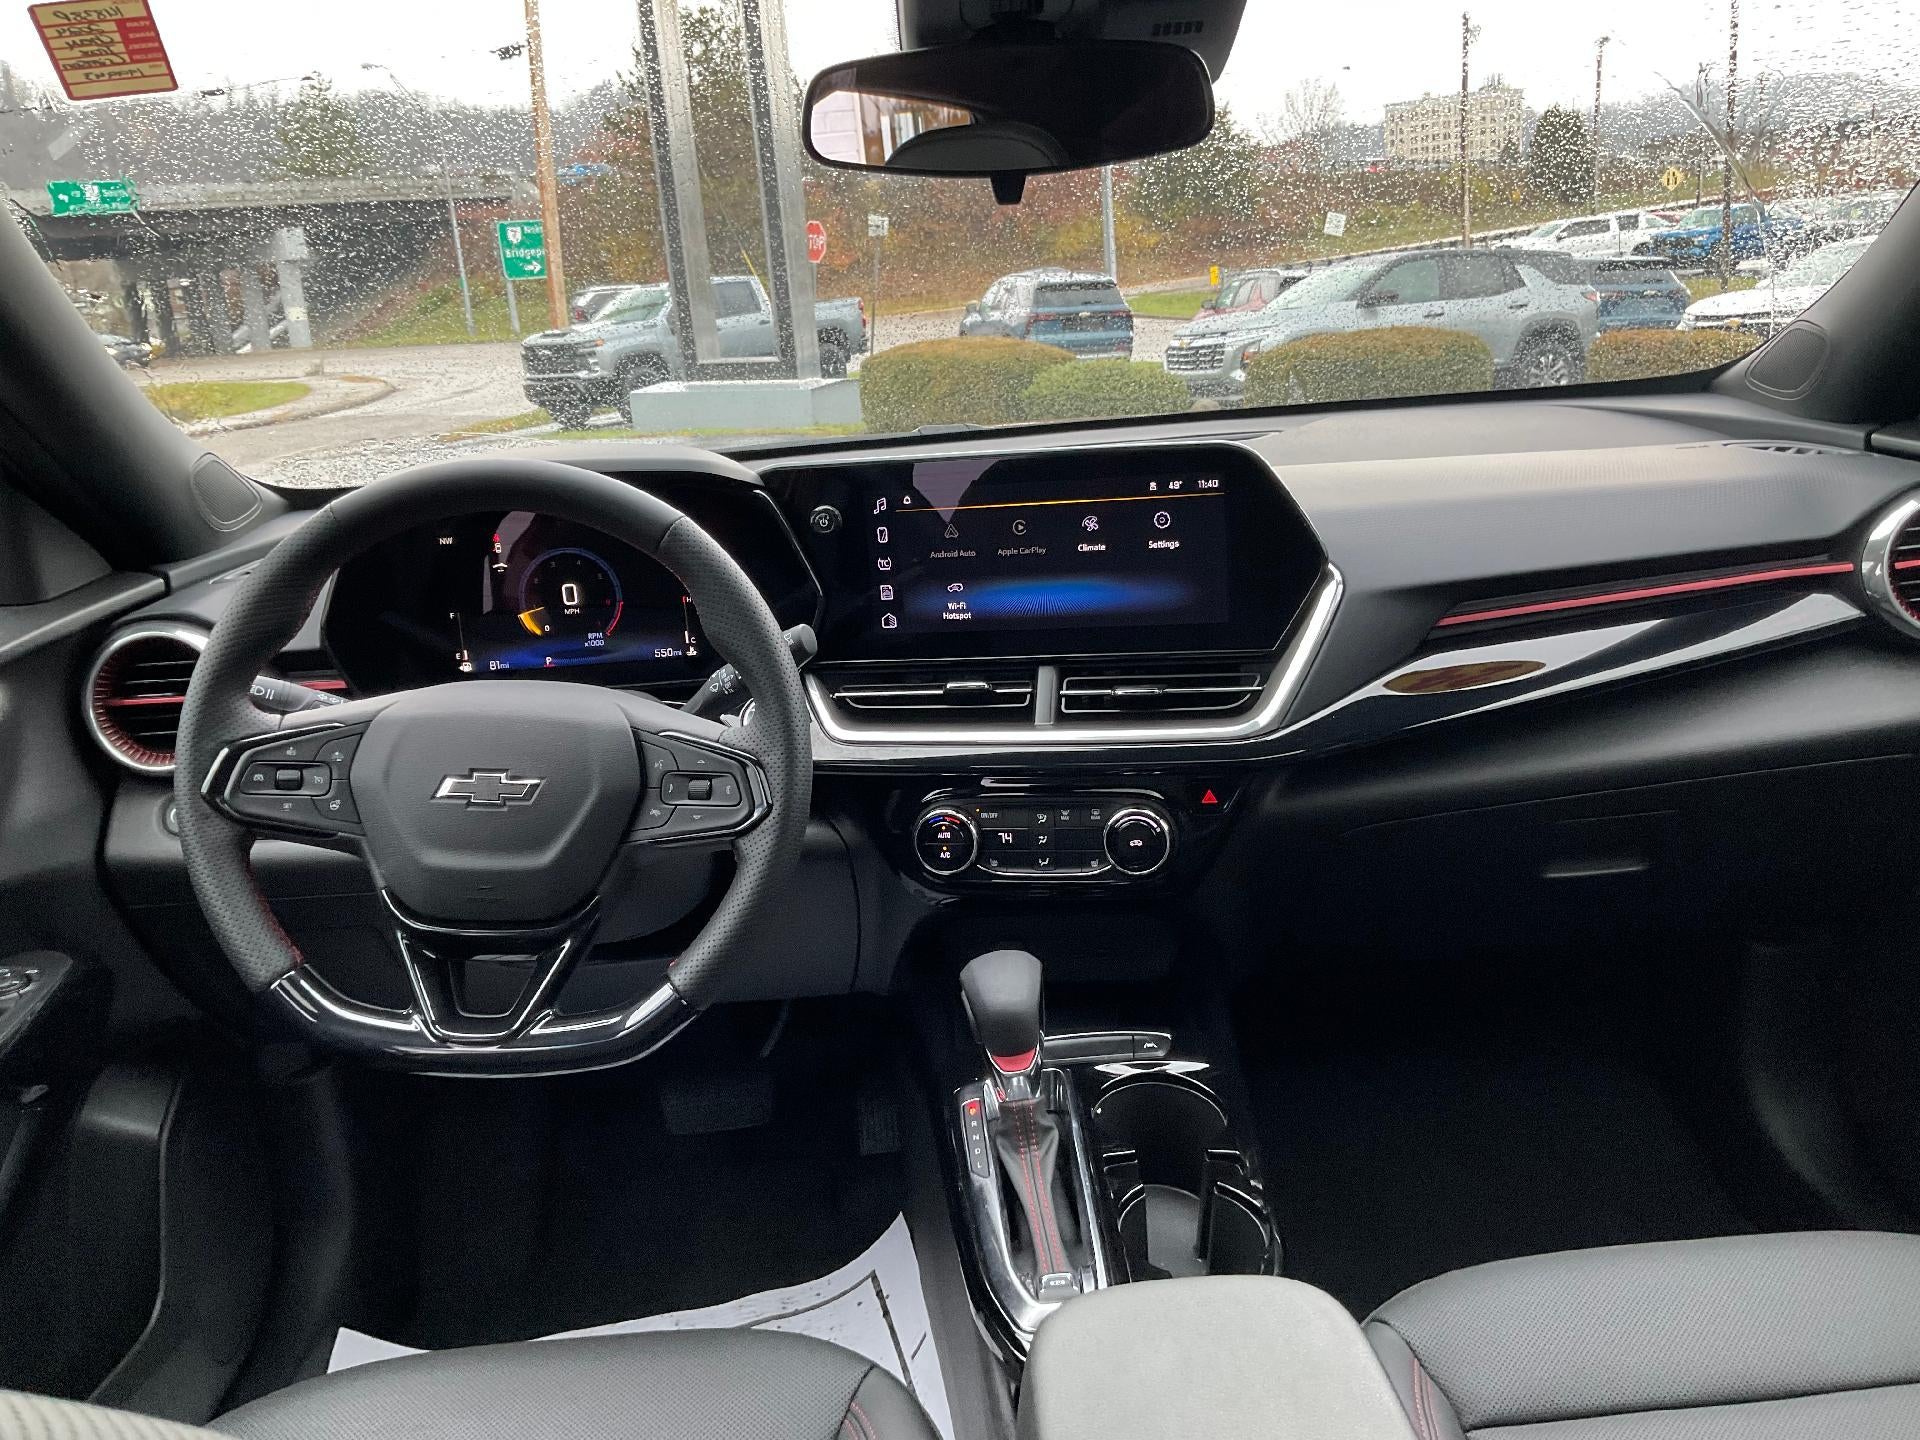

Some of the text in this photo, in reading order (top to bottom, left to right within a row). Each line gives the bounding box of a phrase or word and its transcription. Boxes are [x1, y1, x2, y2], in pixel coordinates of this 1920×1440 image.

[1198, 479, 1220, 489] 11:40
[439, 536, 453, 545] NW
[1148, 539, 1180, 551] Settings
[997, 546, 1047, 557] Apple CarPlay
[1077, 542, 1107, 552] Climate
[930, 549, 976, 560] Android Auto
[561, 583, 578, 606] 0
[686, 596, 692, 604] H
[947, 601, 966, 610] Wi-Fi
[449, 612, 455, 620] F
[564, 607, 581, 616] MPH
[942, 611, 972, 622] Hotspot
[587, 631, 604, 640] RPM
[583, 639, 605, 648] x1000
[455, 652, 462, 660] E
[545, 657, 552, 666] P
[937, 831, 951, 839] AUTO
[997, 832, 1013, 844] 74
[940, 851, 951, 859] A/C
[971, 1120, 978, 1128] R
[977, 1161, 983, 1169] L
